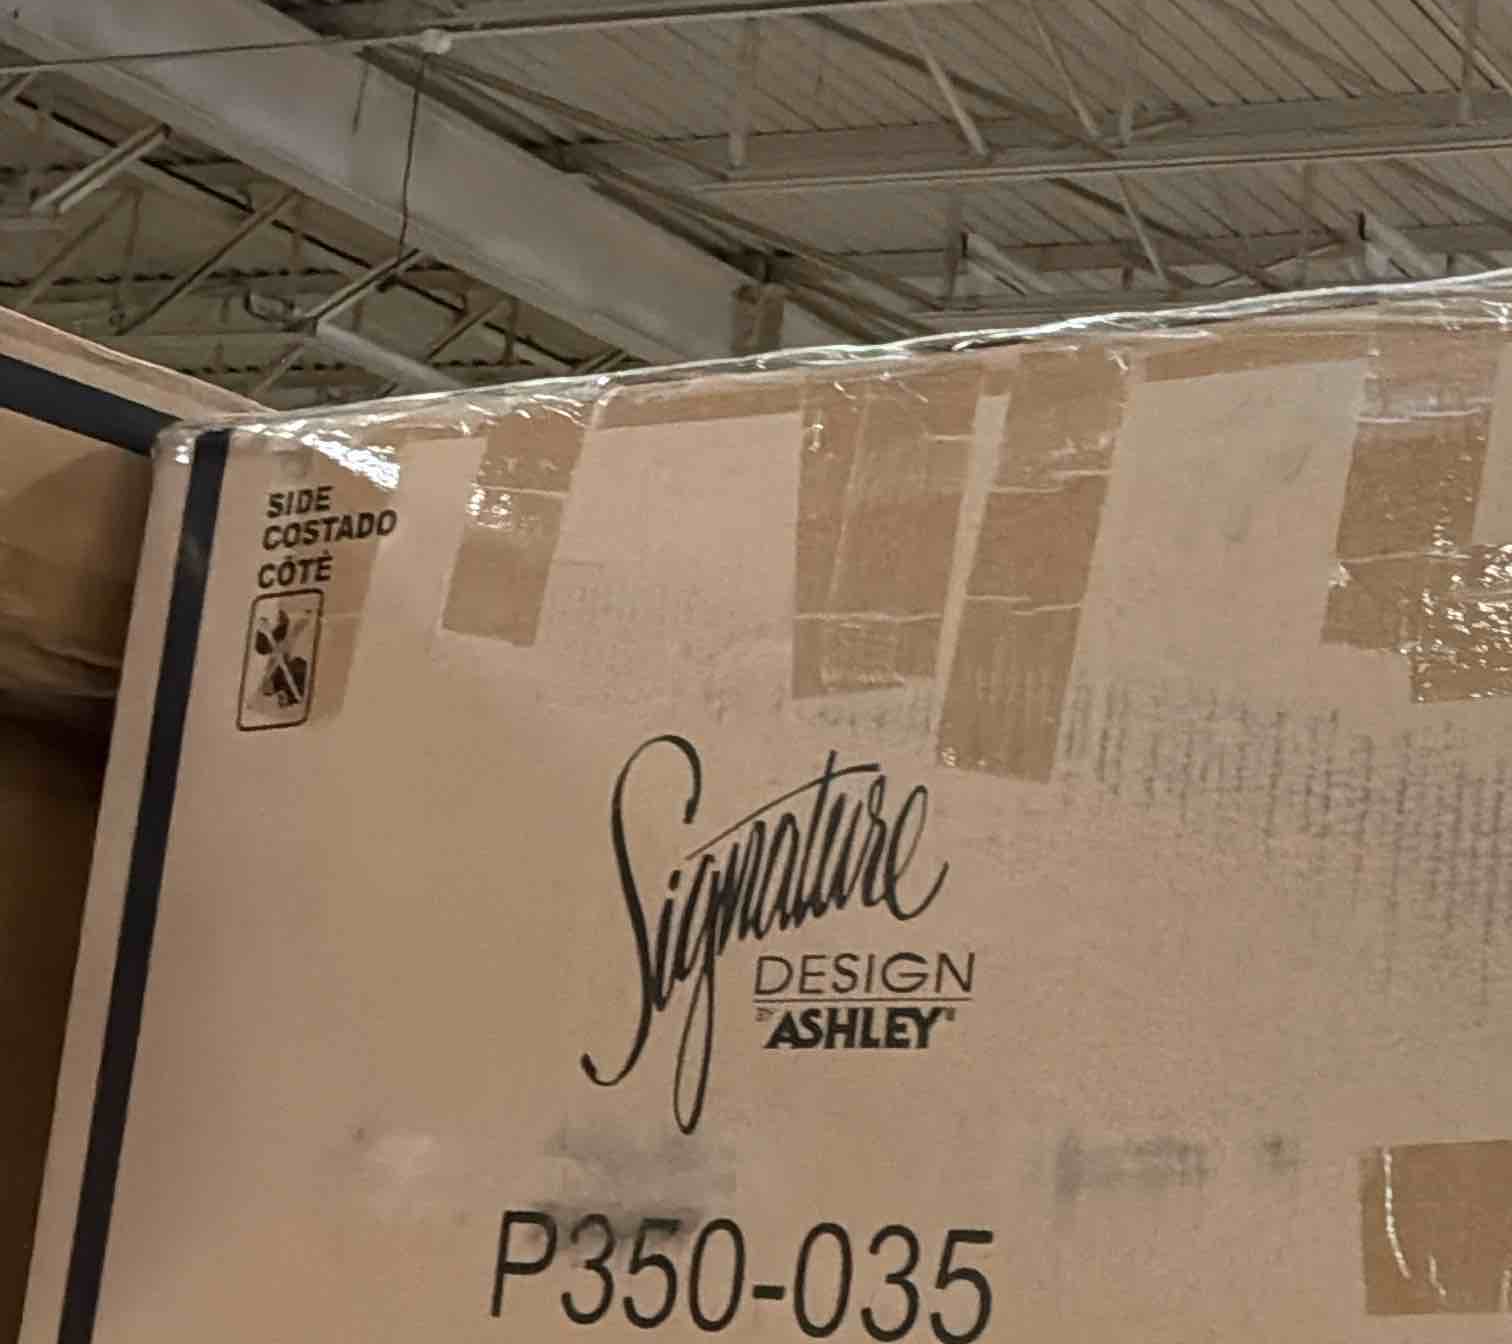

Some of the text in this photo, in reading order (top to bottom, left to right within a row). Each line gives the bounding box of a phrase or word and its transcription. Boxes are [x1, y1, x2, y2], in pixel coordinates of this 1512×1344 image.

[266, 485, 334, 519] SIDE
[262, 509, 398, 551] COSTADO
[580, 734, 950, 1135] Signature
[754, 951, 976, 996] DESIGN
[762, 1006, 944, 1050] ASHLEY
